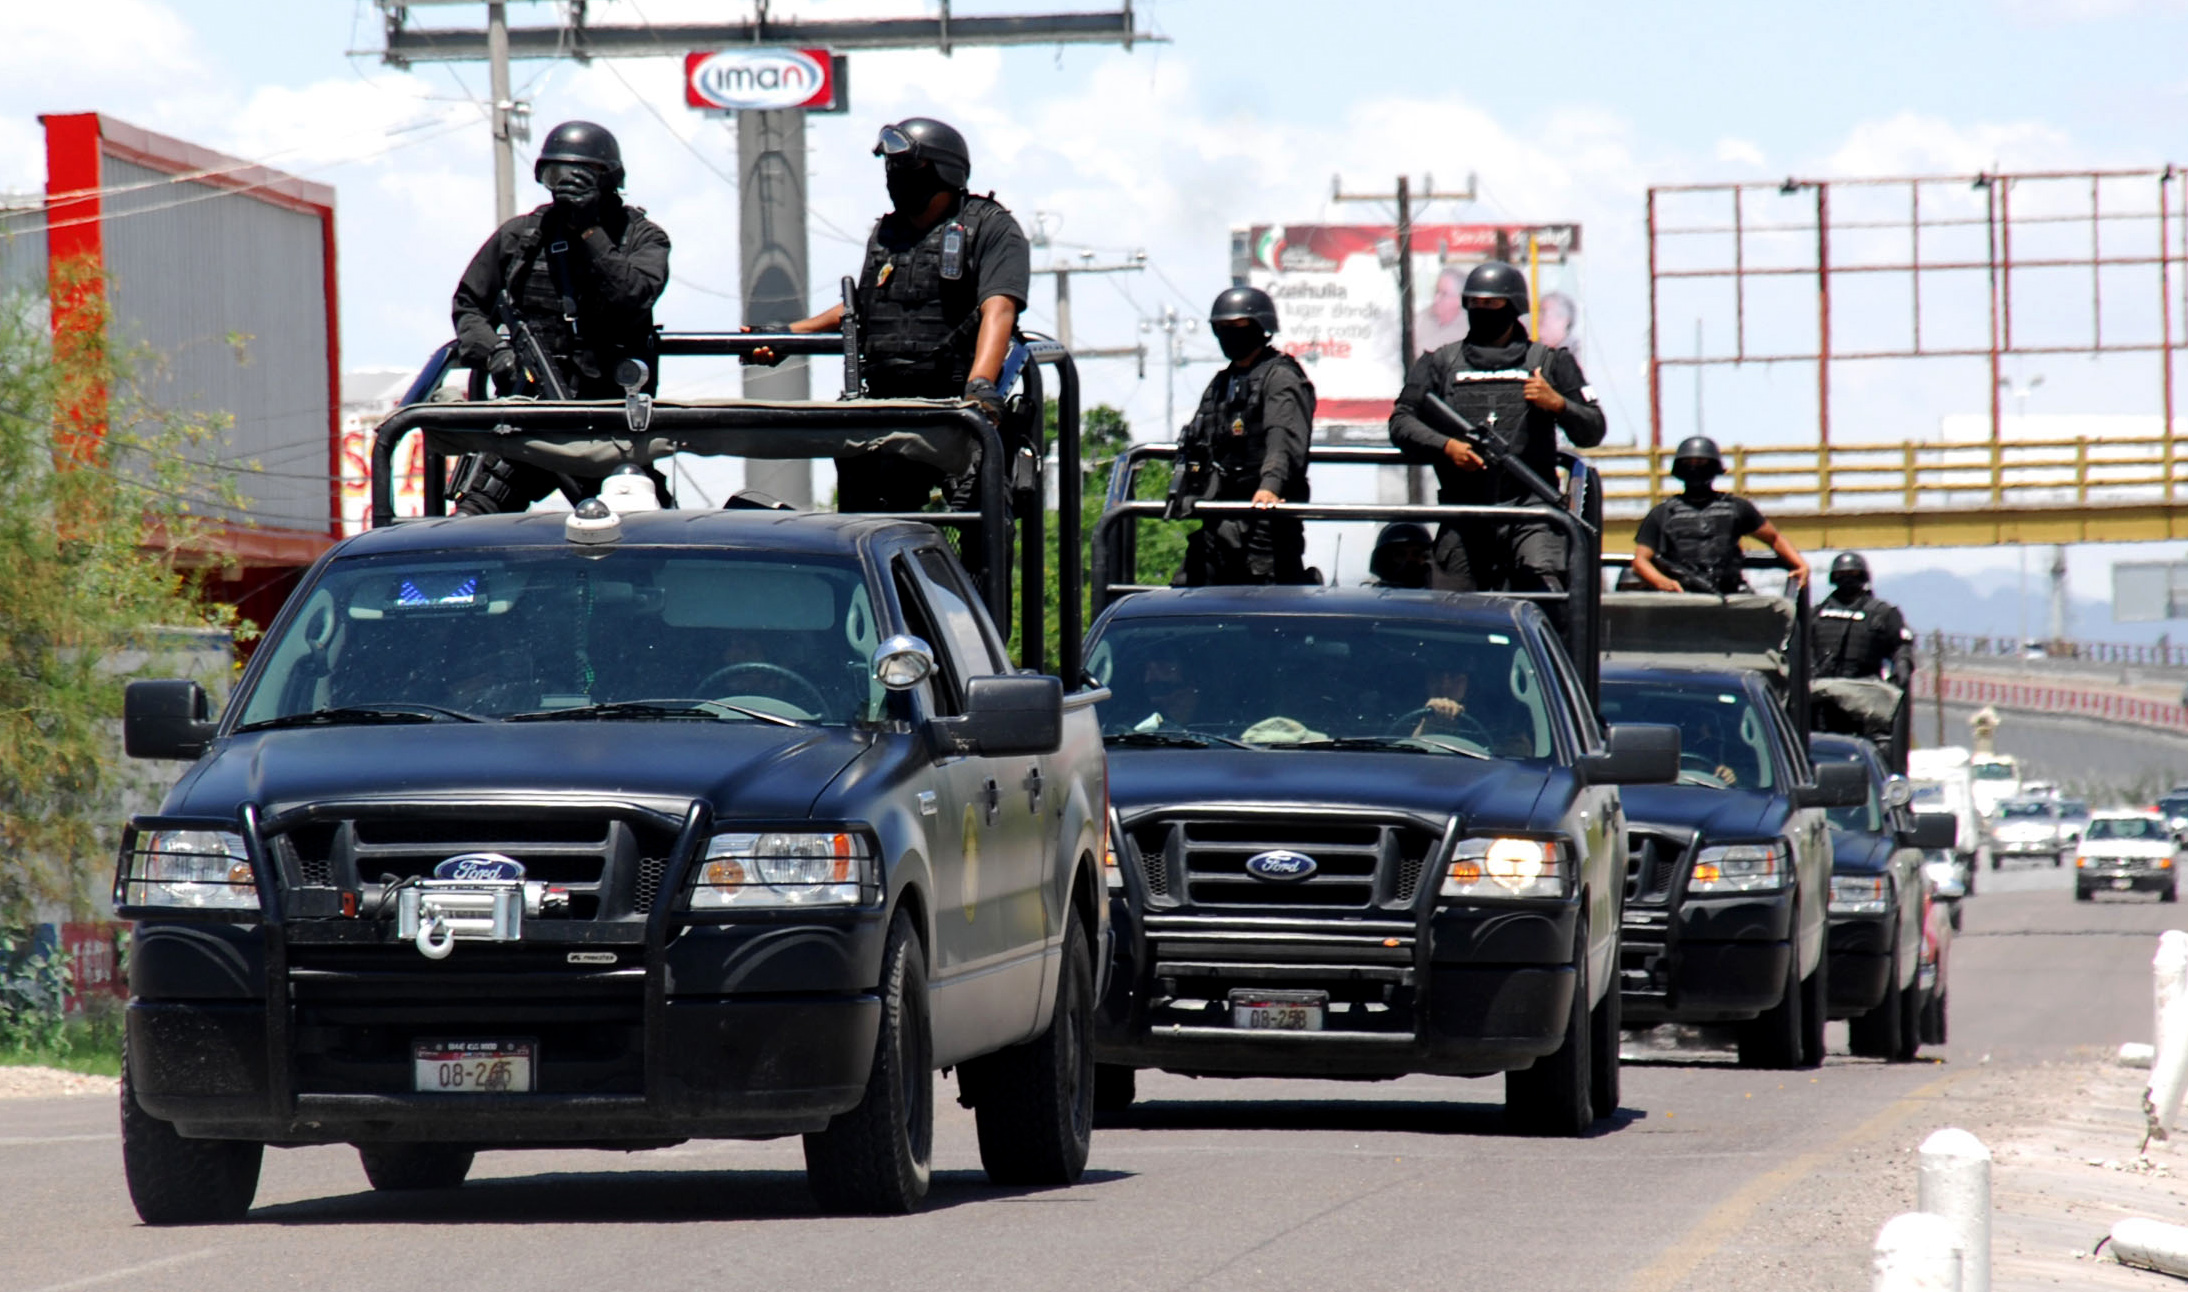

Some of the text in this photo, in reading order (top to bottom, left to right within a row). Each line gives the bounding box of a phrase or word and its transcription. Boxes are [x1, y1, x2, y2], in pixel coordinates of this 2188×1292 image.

[717, 66, 803, 91] iman
[1266, 281, 1347, 299] Coahuila
[1331, 301, 1381, 318] donde
[453, 860, 503, 880] Ford
[1261, 855, 1301, 873] Ford
